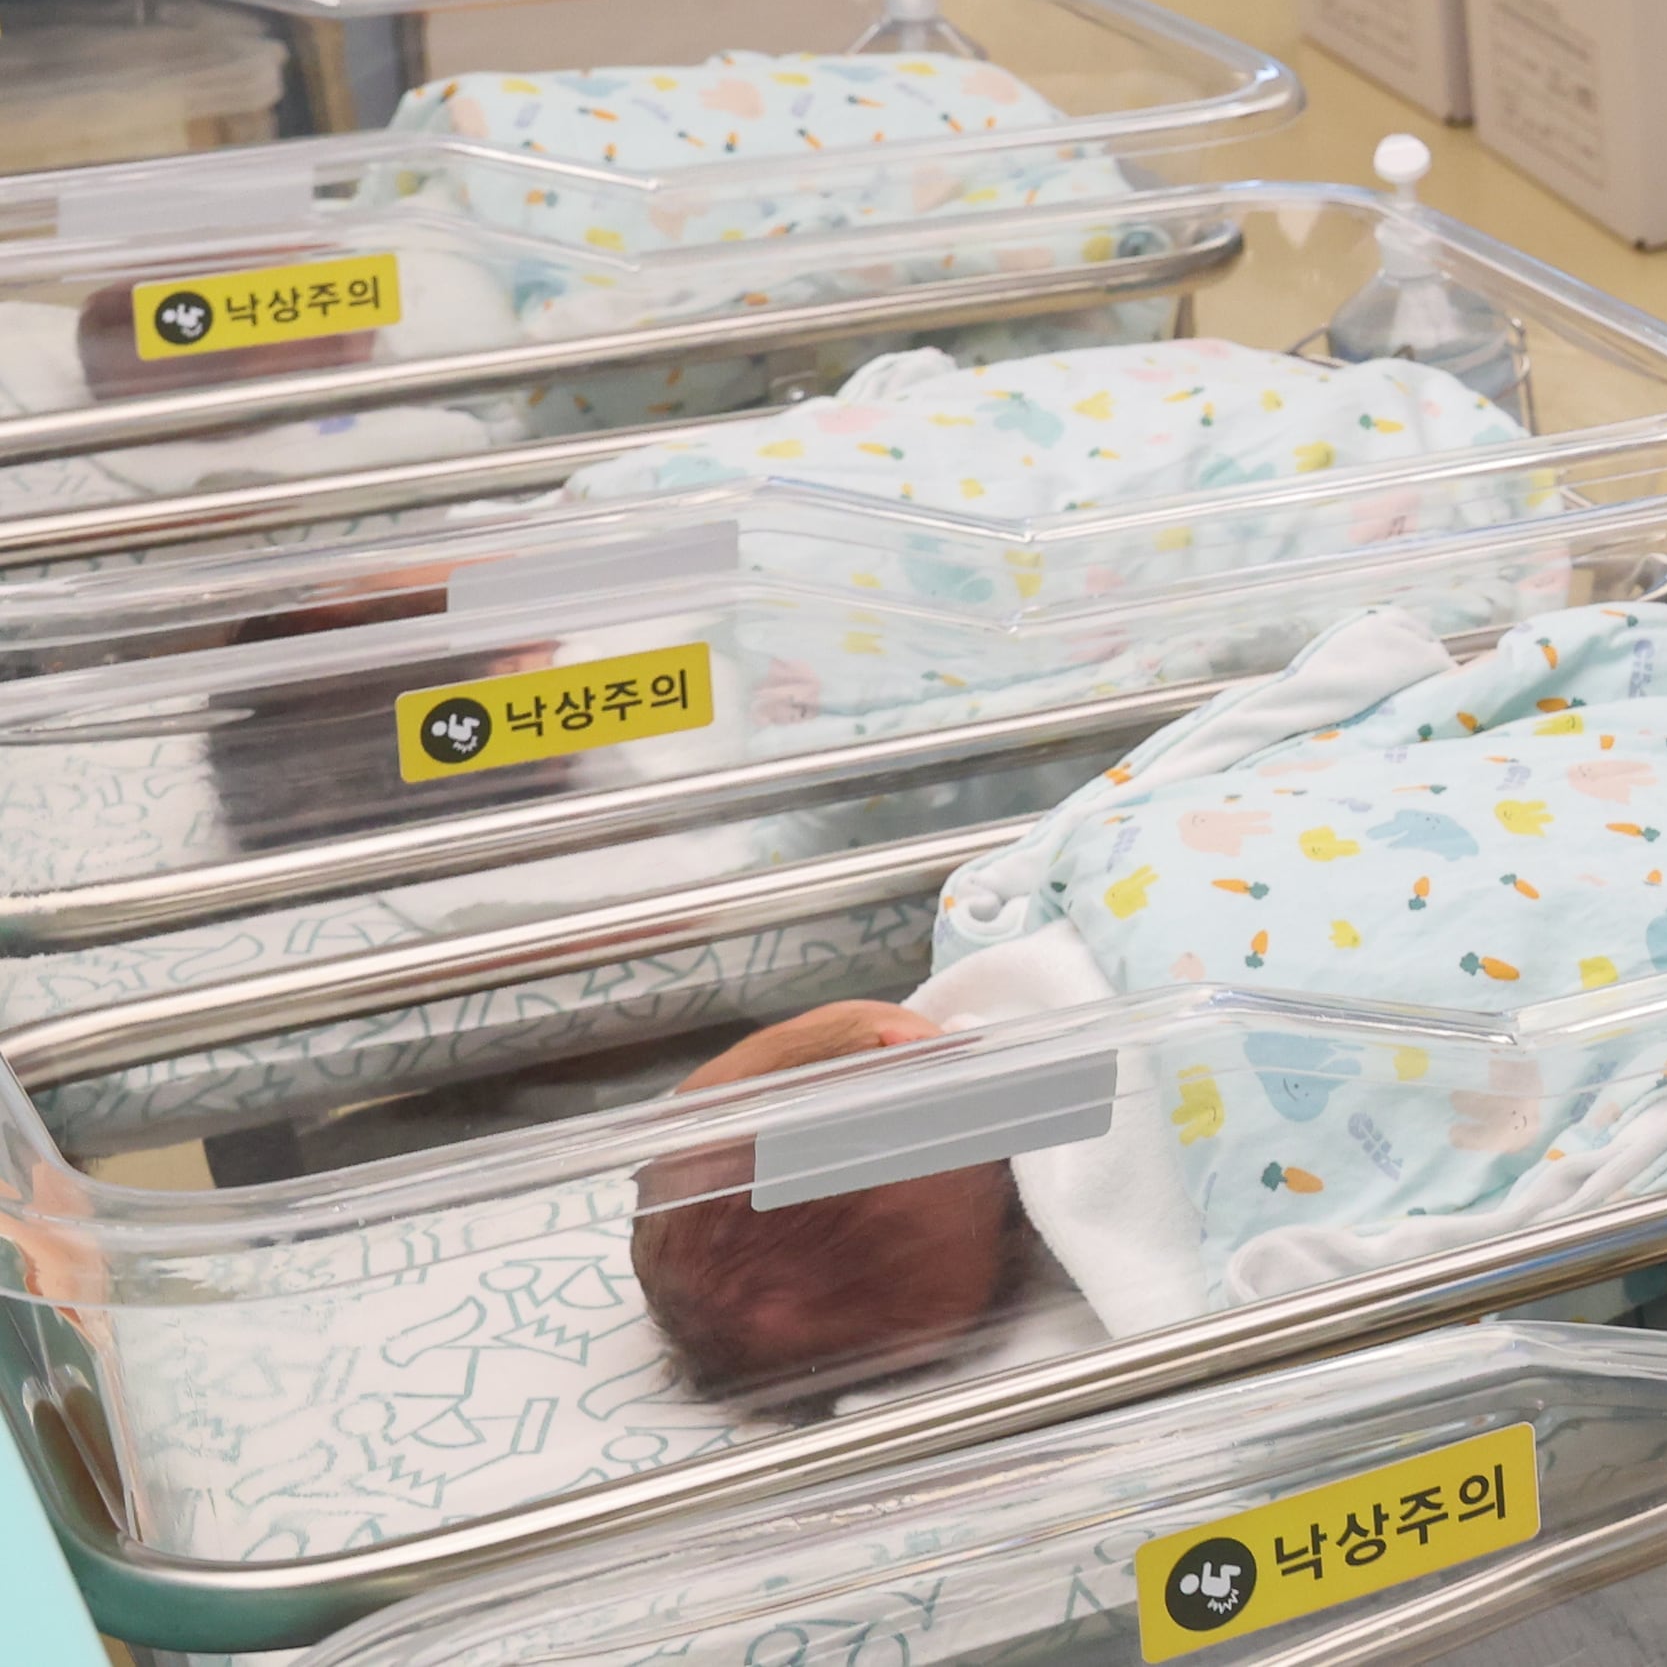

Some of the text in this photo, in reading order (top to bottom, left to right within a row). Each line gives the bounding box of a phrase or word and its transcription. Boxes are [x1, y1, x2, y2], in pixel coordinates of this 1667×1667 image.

[225, 275, 381, 327] 낙상주의
[504, 668, 690, 738] 낙상주의
[1273, 1463, 1508, 1581] 낙상주의
